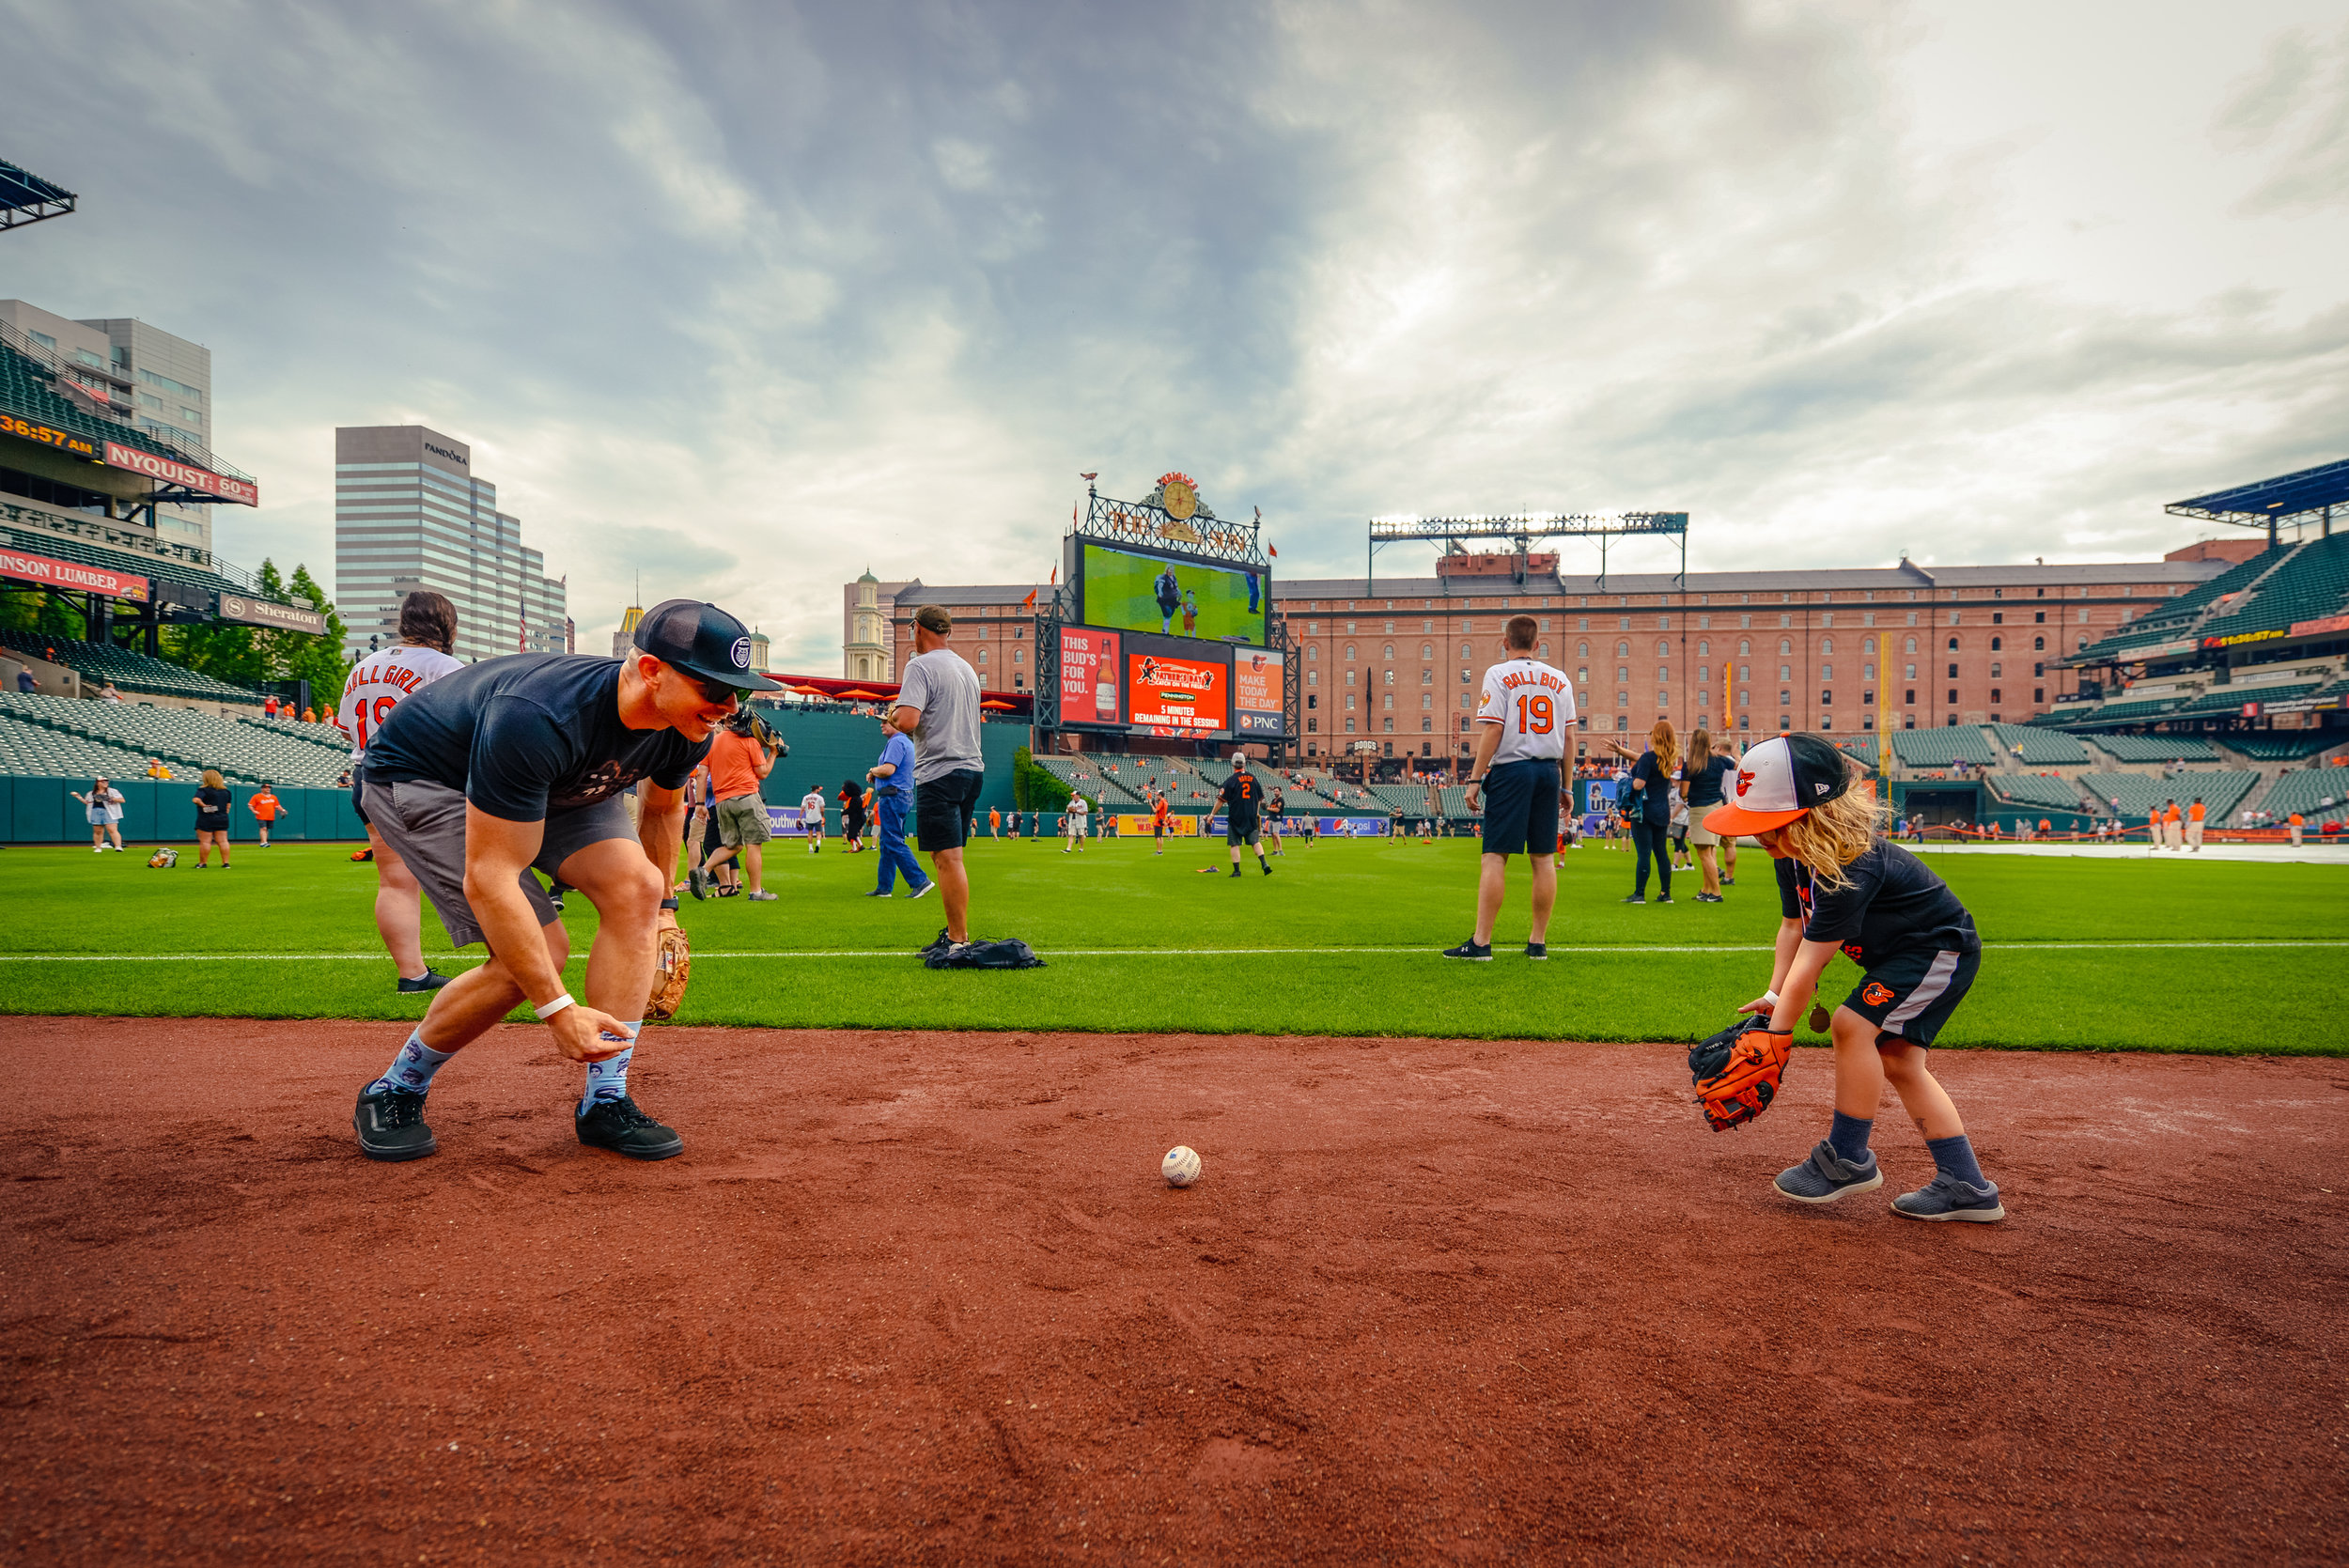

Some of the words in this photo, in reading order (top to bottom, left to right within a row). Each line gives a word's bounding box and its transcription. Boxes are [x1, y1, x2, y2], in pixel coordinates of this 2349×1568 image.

[68, 439, 93, 455] AM
[112, 446, 210, 488] NYQUIST
[219, 478, 241, 494] 60
[1109, 511, 1151, 536] THE
[1209, 530, 1245, 552] SUN
[54, 566, 117, 591] LUMBER
[255, 602, 318, 626] Sheraton
[1063, 636, 1088, 650] THIS
[1064, 651, 1097, 666] BUD'S
[1063, 665, 1085, 679] FOR
[1188, 673, 1204, 684] DAY
[382, 665, 422, 694] GIRL
[1239, 675, 1266, 686] MAKE
[1502, 671, 1537, 691] BALL
[1540, 672, 1566, 694] BOY
[1063, 680, 1088, 694] YOU.
[1239, 685, 1268, 697] TODAY
[1160, 691, 1194, 700] PENNINGTON
[1239, 696, 1257, 706] THE
[1160, 705, 1166, 714] 5
[1167, 706, 1194, 717] MINUTES
[1517, 694, 1553, 735] 19
[1134, 713, 1171, 724] REMAINING
[1172, 716, 1179, 725] IN
[1180, 716, 1192, 726] THE
[1193, 718, 1220, 728] SESSION
[1253, 716, 1278, 729] PNC
[1241, 783, 1251, 799] 2
[1348, 820, 1371, 833] ppsi
